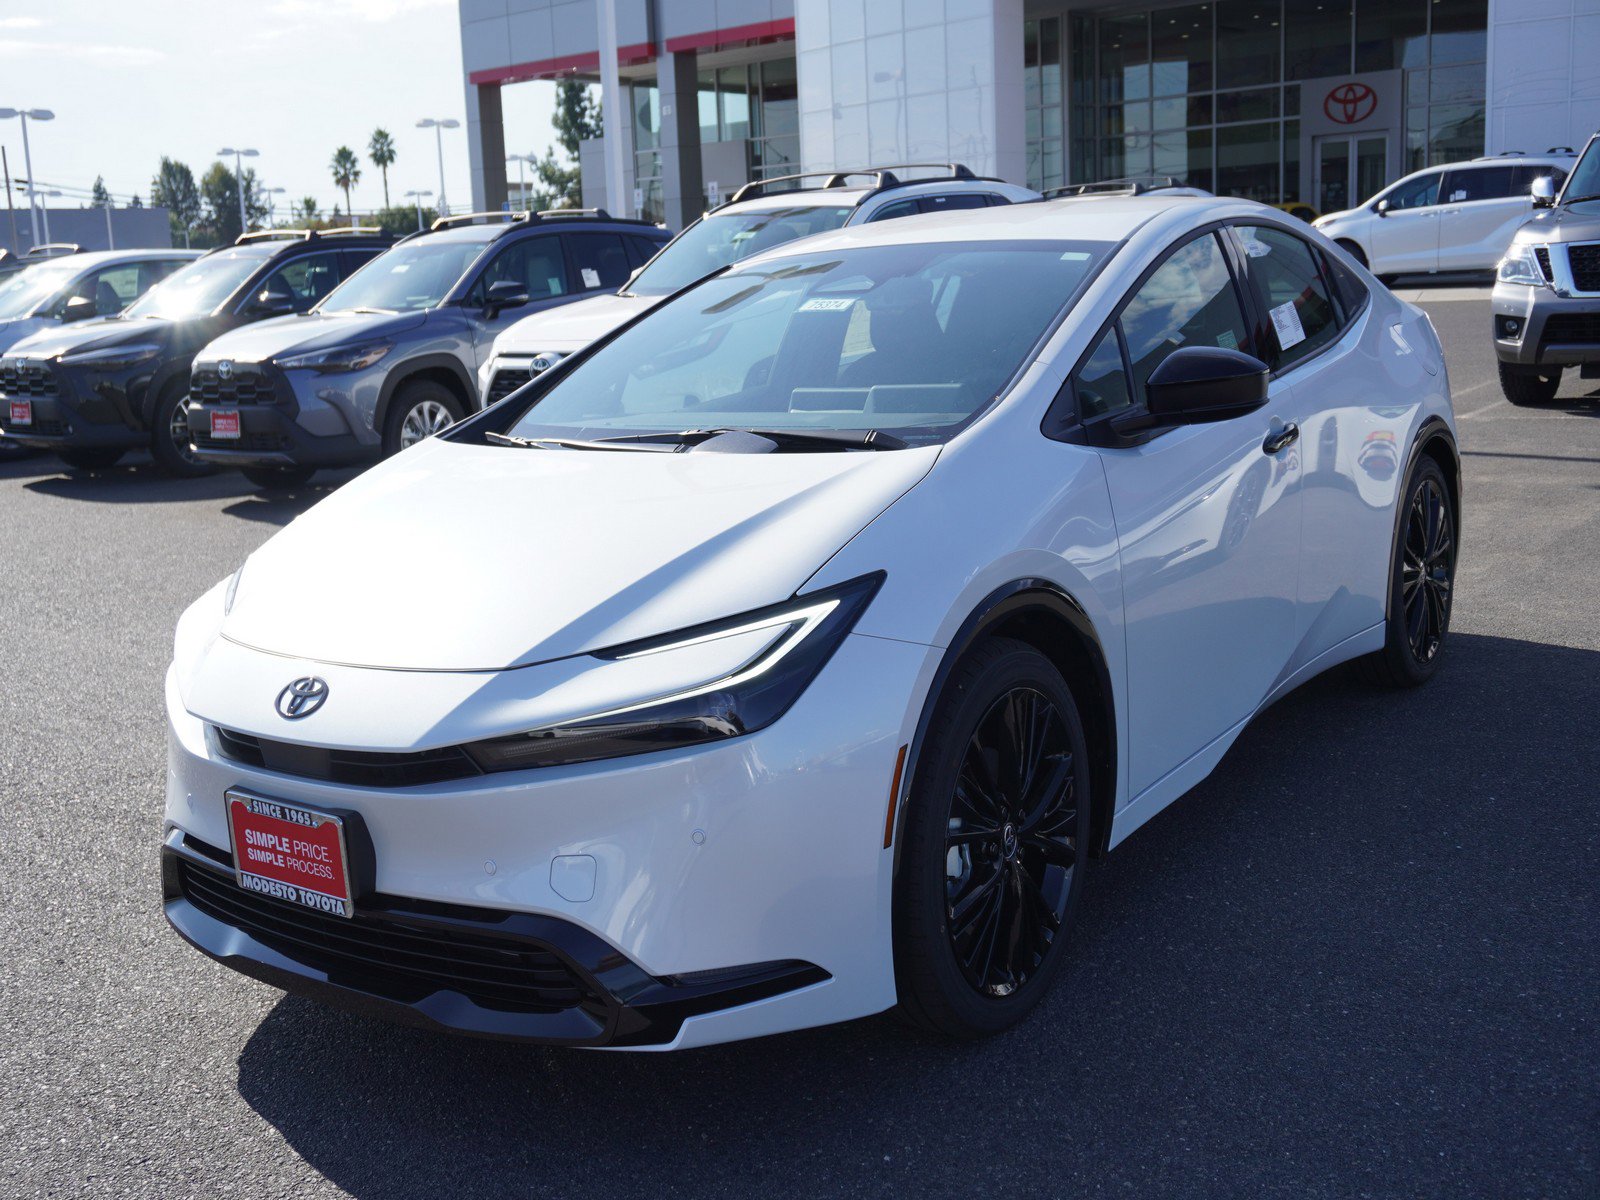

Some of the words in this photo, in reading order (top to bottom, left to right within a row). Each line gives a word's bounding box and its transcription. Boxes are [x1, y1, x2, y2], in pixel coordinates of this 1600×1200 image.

[252, 801, 282, 818] SINCE
[284, 808, 311, 826] 1965
[244, 829, 291, 853] SIMPLE
[293, 840, 333, 863] PRICE.
[247, 848, 285, 868] SIMPLE
[287, 857, 336, 880] PROCESS.
[242, 874, 297, 901] MODESTO
[299, 890, 346, 915] TOYOTA
